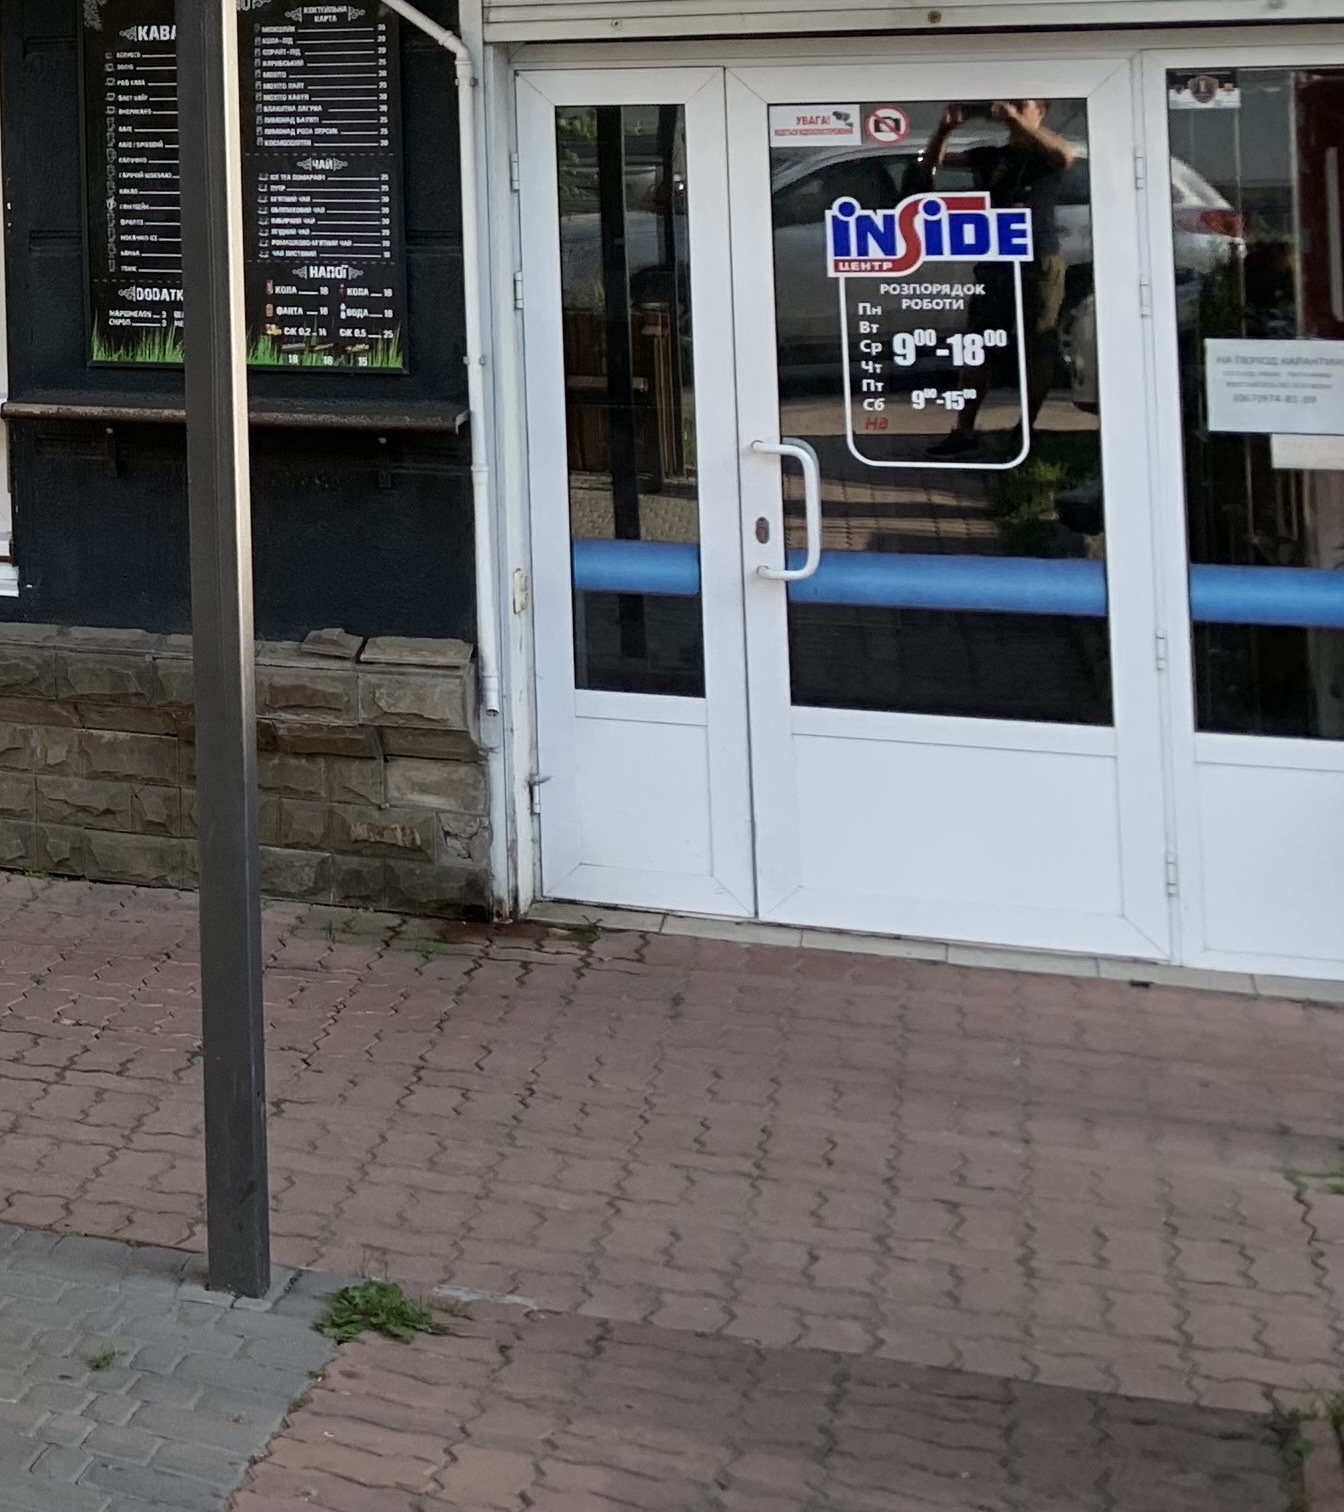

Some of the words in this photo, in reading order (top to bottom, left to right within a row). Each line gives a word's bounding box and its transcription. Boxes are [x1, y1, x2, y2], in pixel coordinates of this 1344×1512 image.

[796, 115, 831, 126] УВАГА!
[311, 157, 333, 170] ЧАЙ
[309, 264, 349, 279] НАПОЇ
[838, 261, 894, 272] ЦЕНТР
[879, 283, 986, 297] РОЗПОРЯДОК
[858, 302, 882, 316] Пн
[902, 298, 965, 310] РОБОТИ
[346, 308, 369, 318] ВОДА
[859, 320, 880, 334] Вт
[859, 340, 883, 356] Ср
[861, 360, 883, 374] Чт
[862, 378, 885, 392] Пт
[863, 397, 886, 412] Сб
